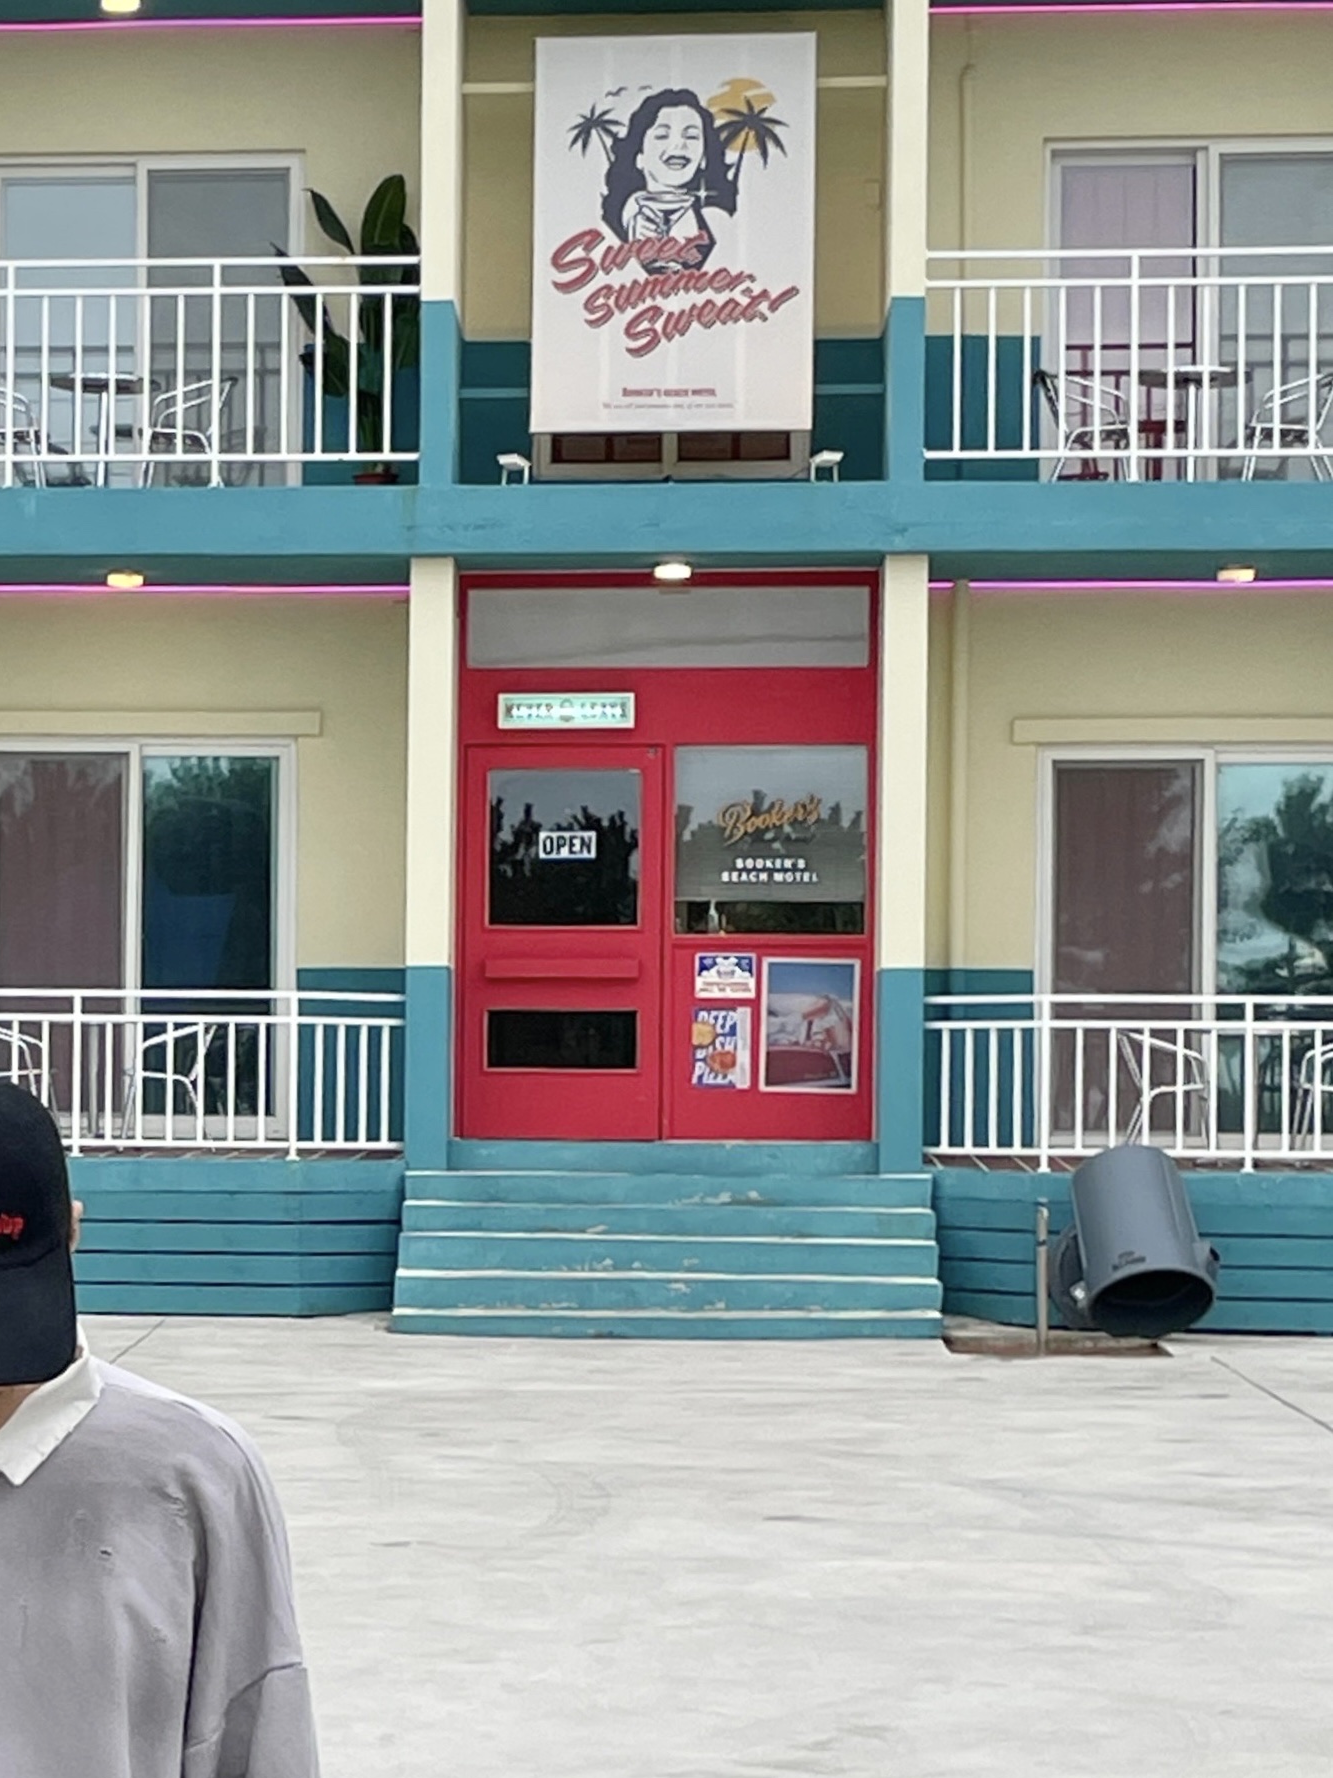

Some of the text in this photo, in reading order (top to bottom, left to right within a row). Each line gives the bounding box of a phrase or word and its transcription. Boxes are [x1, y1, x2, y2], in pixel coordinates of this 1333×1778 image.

[551, 228, 709, 294] Sweet
[624, 286, 799, 358] Sweat!
[718, 793, 821, 847] Booker's
[542, 835, 592, 856] OPEN
[735, 858, 806, 870] BOOKER'S
[721, 871, 818, 882] BEACH MOTEL
